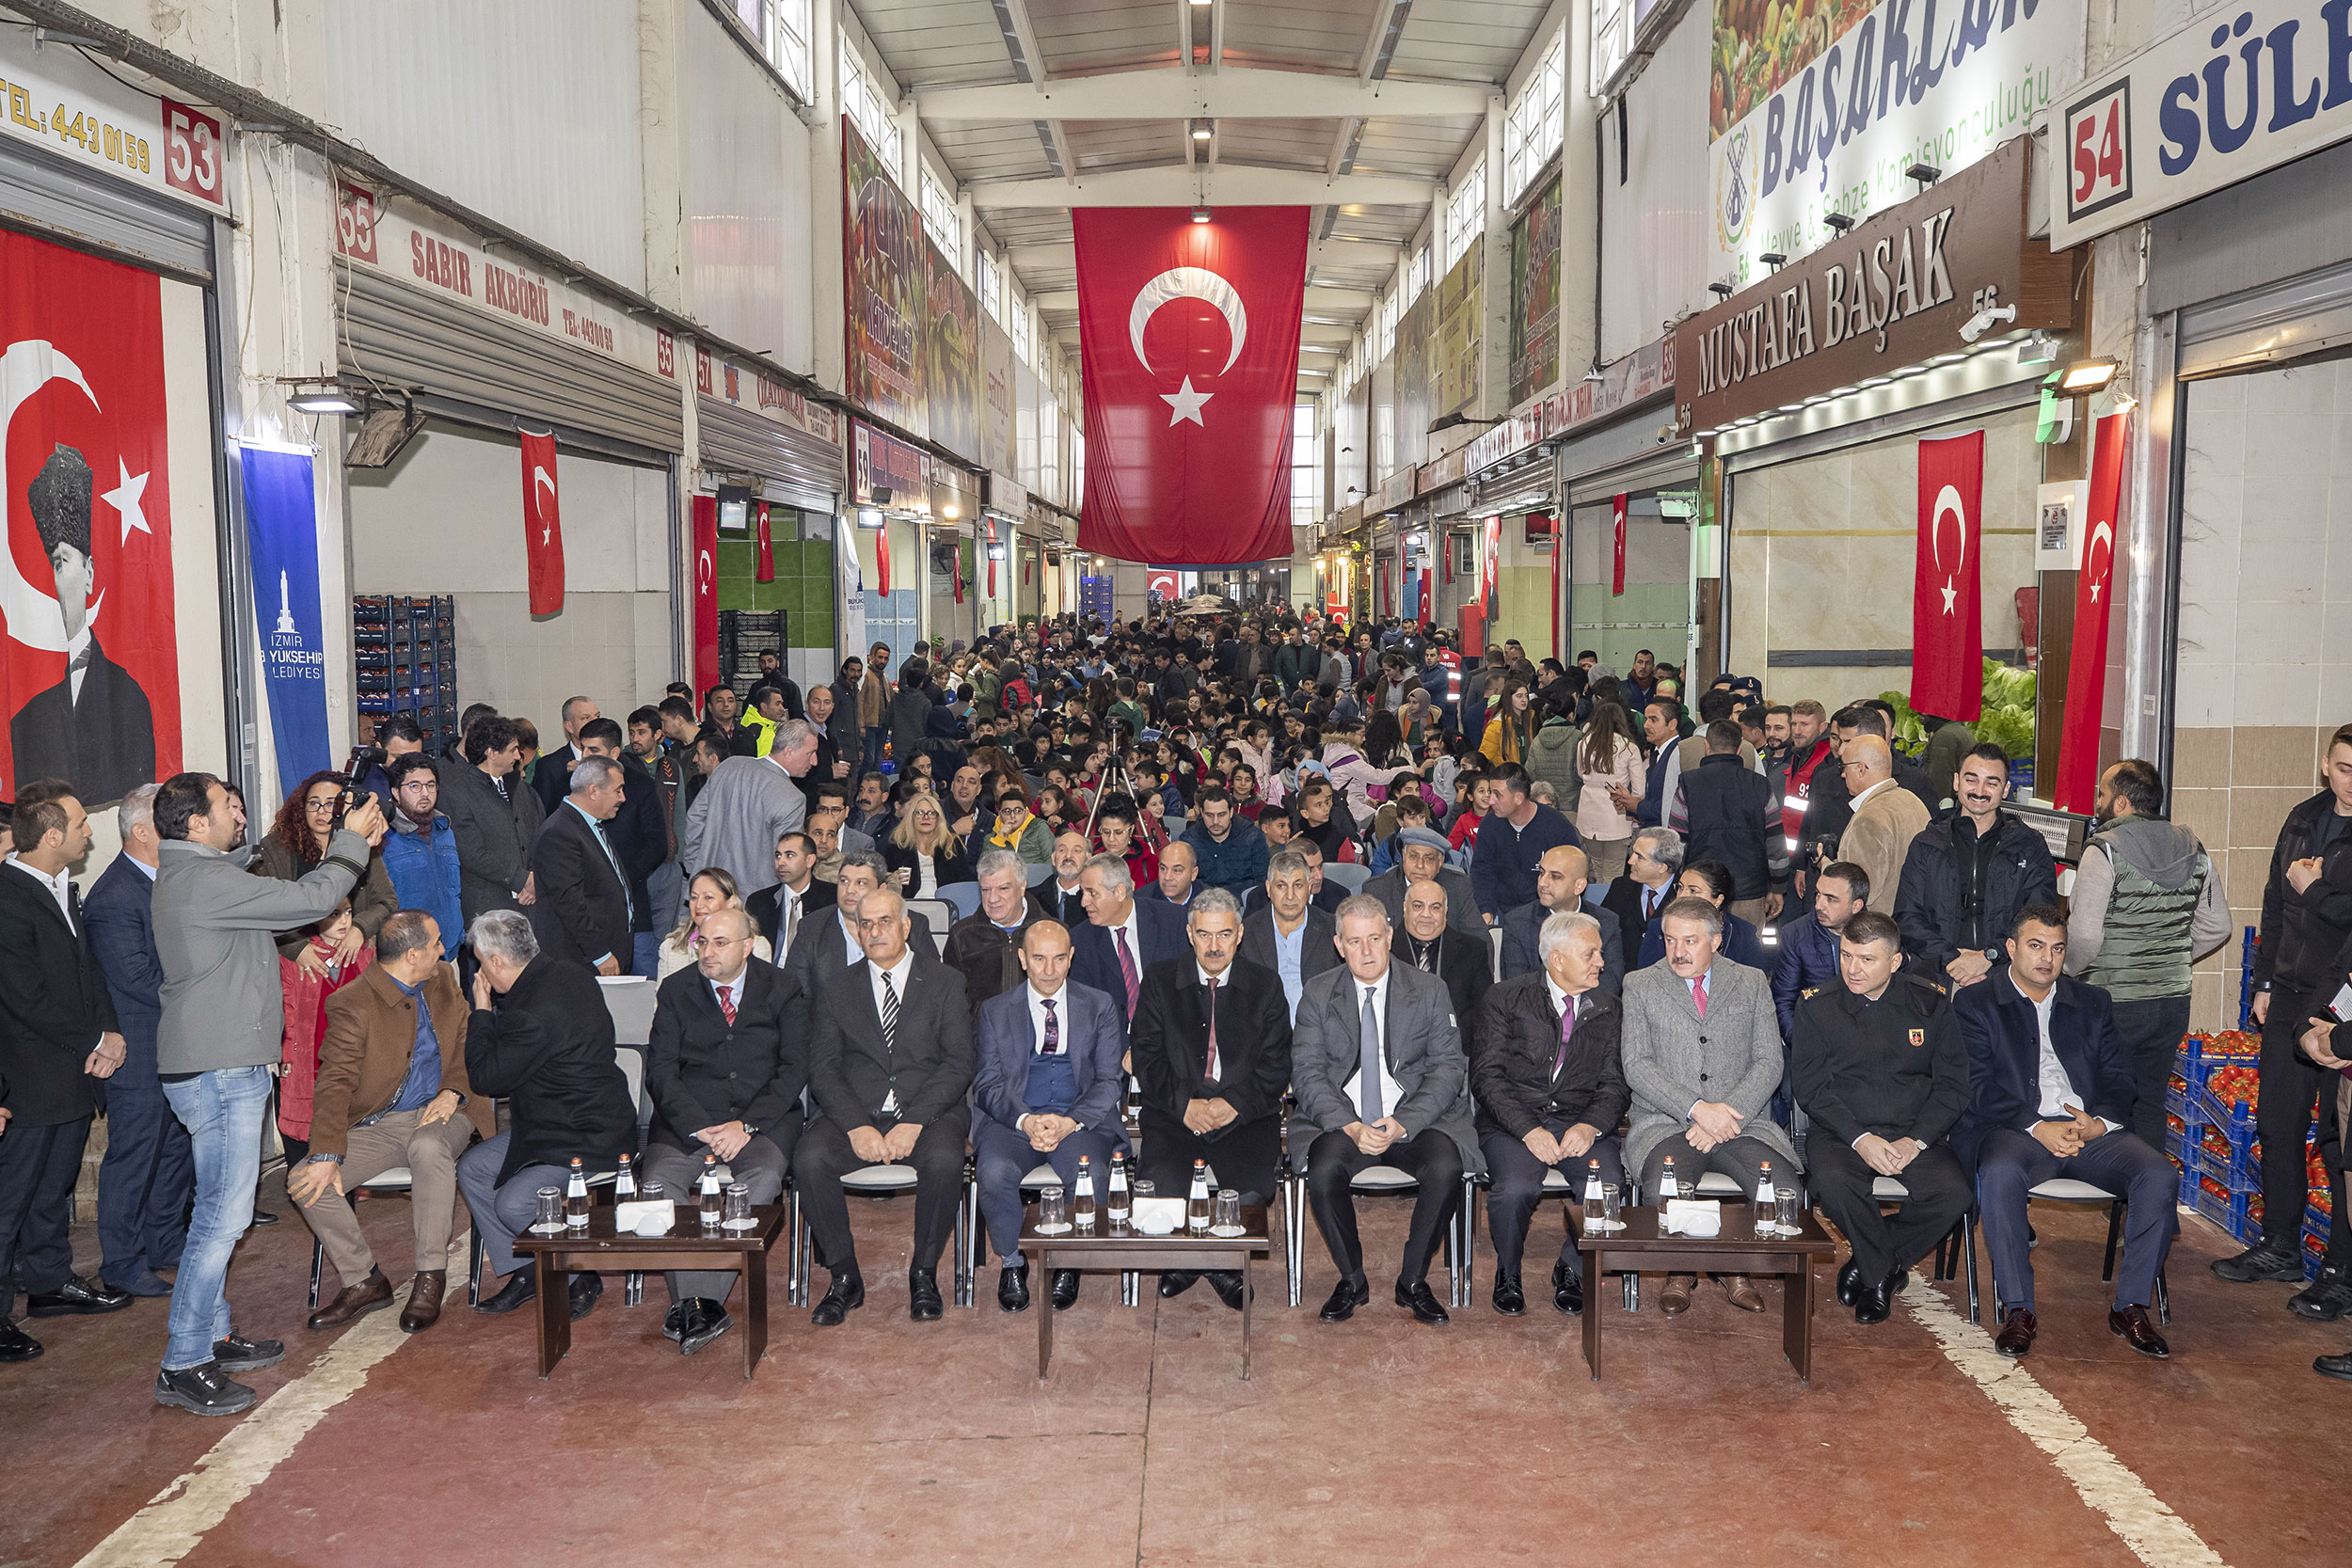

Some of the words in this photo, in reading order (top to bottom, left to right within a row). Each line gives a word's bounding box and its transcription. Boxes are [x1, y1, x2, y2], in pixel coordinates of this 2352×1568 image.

[170, 110, 216, 192] 53
[2073, 98, 2123, 203] 54
[339, 196, 373, 254] 55
[1808, 204, 1816, 241] &
[410, 230, 472, 298] SABIR
[485, 262, 549, 327] AKBÖRÜ
[563, 308, 580, 340] TEL:
[1740, 250, 1750, 283] 56
[1696, 278, 1816, 398] MUSTAFA
[1823, 205, 1954, 354] BAŞAK
[1972, 284, 1998, 315] 56
[660, 331, 673, 373] 55
[698, 350, 710, 390] 57
[1680, 402, 1692, 430] 56
[858, 448, 868, 491] 59
